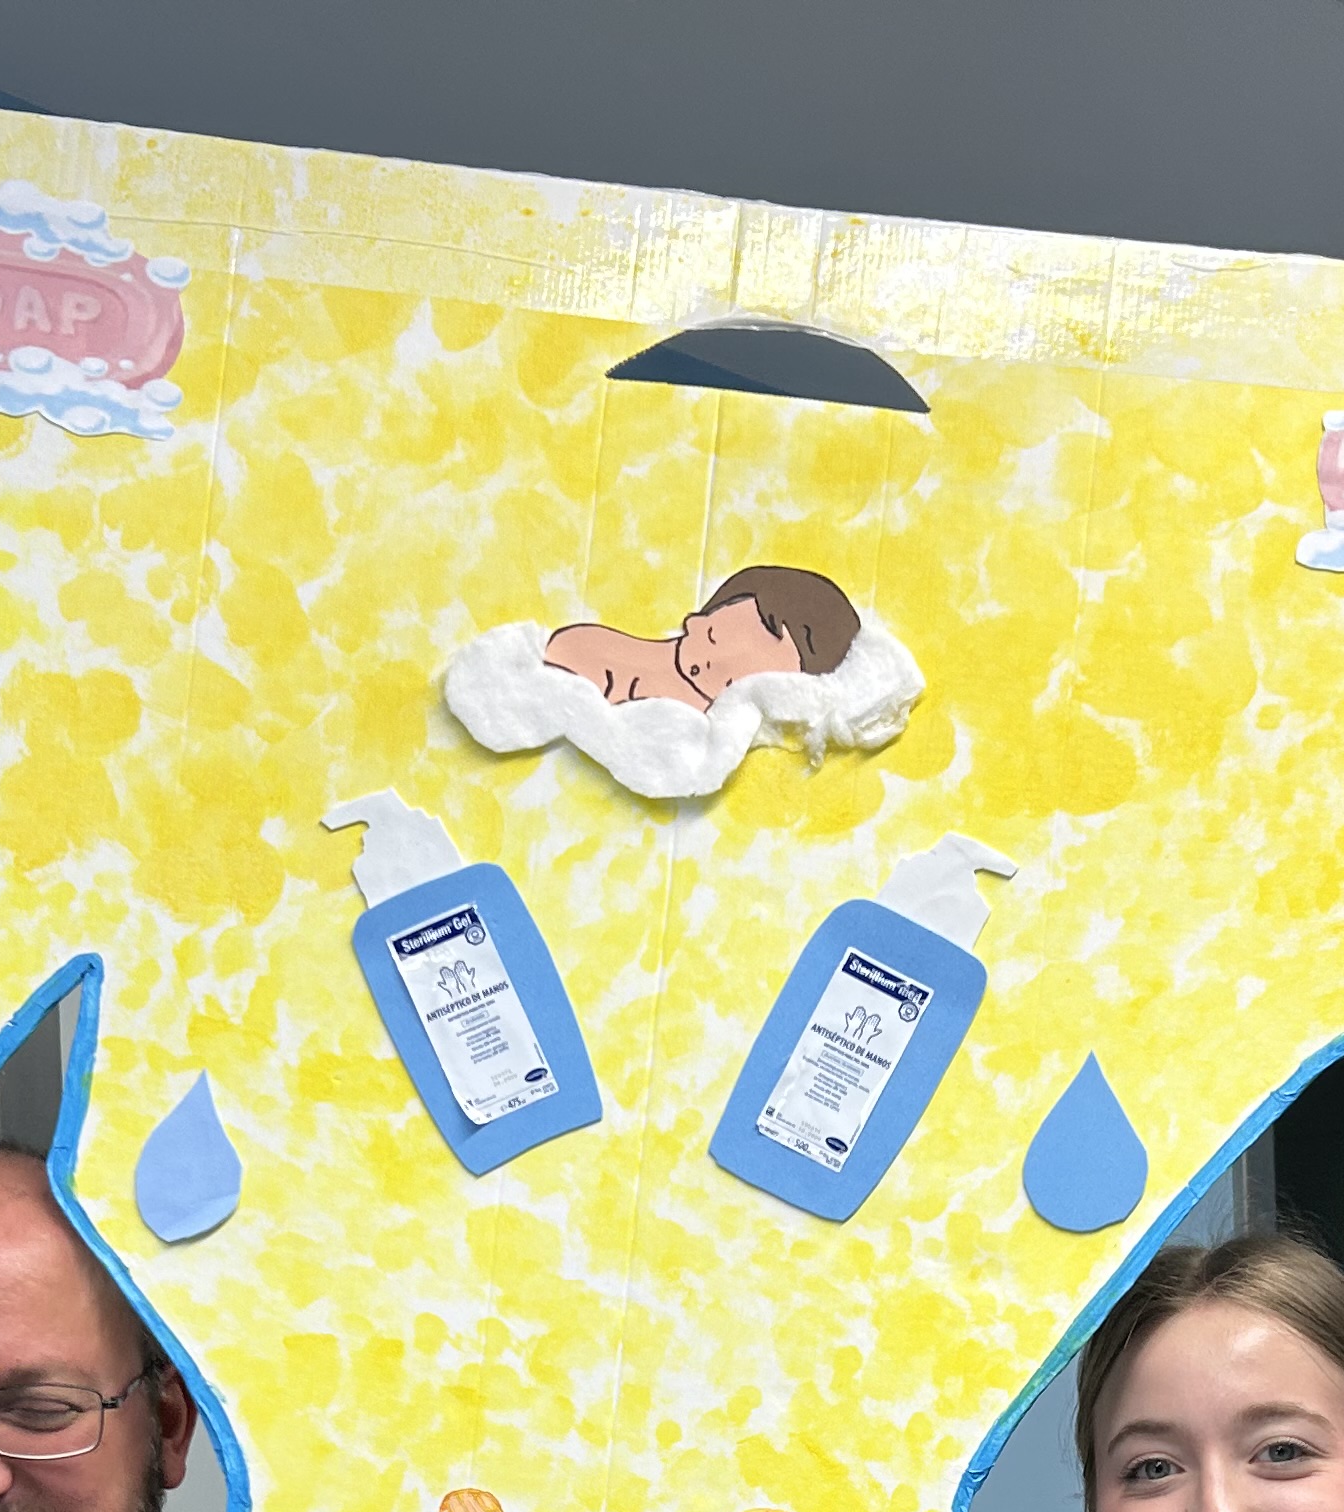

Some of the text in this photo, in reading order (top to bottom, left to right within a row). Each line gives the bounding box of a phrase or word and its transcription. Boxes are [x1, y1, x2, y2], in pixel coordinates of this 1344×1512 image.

[471, 988, 481, 1003] DE
[481, 980, 510, 998] MANOS
[855, 1045, 866, 1057] DE
[865, 1051, 892, 1071] MANOS
